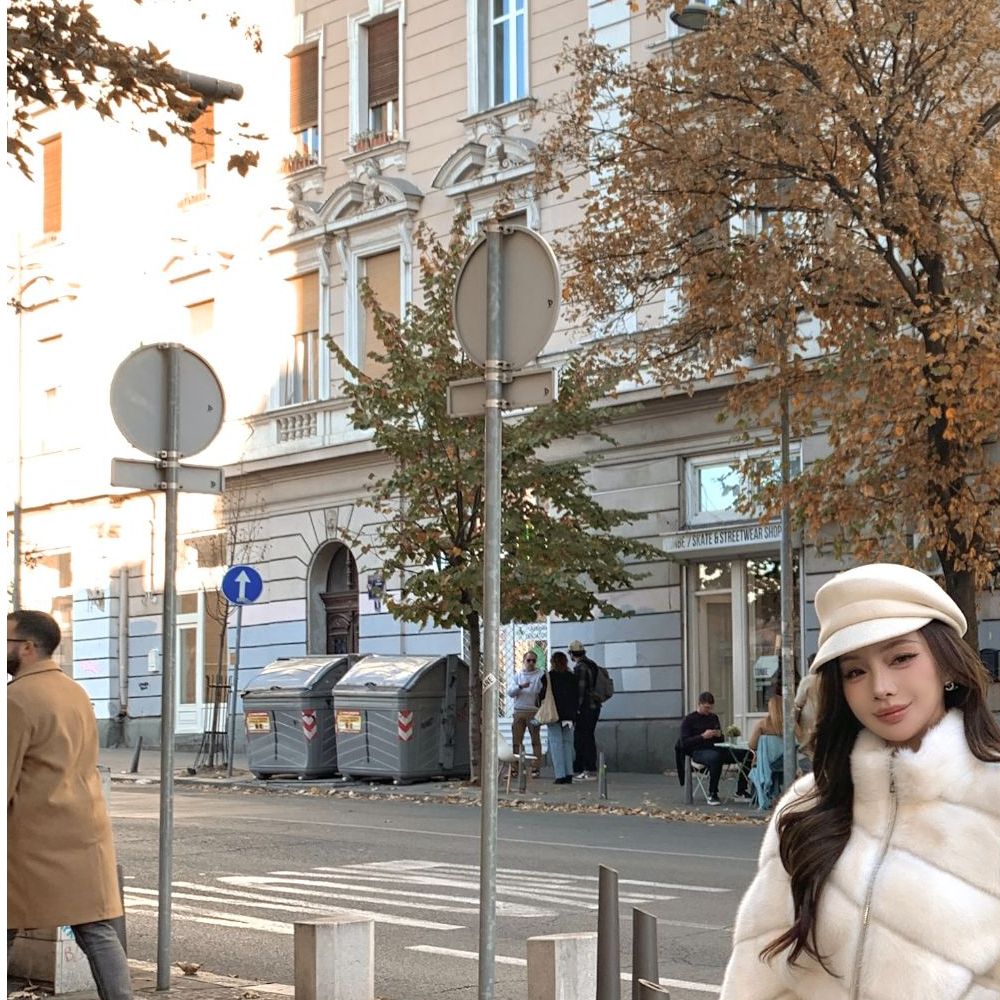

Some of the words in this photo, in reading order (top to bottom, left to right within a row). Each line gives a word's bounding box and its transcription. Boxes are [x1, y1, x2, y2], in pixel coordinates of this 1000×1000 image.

[692, 533, 712, 547] SKATE
[720, 526, 763, 543] STREETWEAR
[764, 524, 782, 539] SHOP
